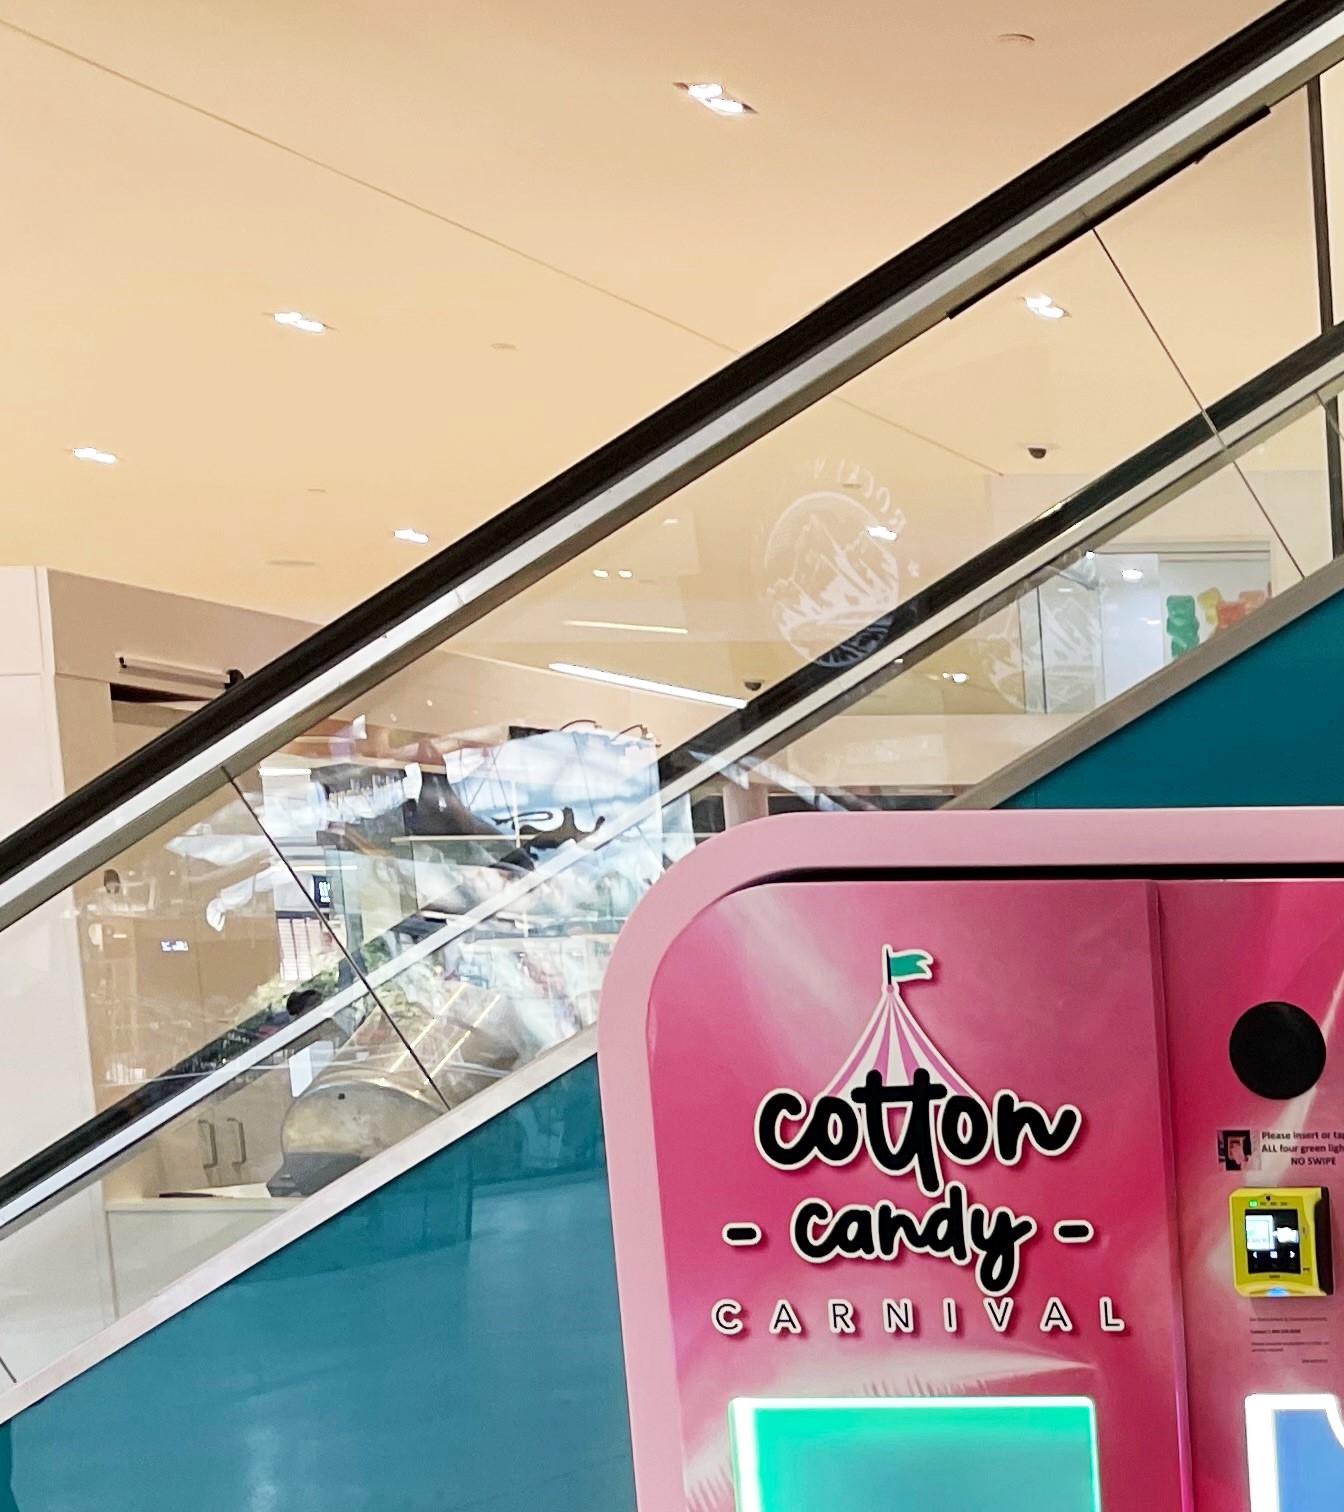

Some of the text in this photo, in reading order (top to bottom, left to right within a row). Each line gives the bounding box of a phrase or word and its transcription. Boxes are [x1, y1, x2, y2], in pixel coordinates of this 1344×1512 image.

[756, 1067, 1081, 1196] cotton
[1261, 1131, 1291, 1139] Please
[1293, 1131, 1319, 1139] insert
[1261, 1144, 1278, 1153] ALL
[1280, 1144, 1298, 1153] four
[1300, 1145, 1326, 1154] green
[1291, 1156, 1336, 1166] NO SWIPE
[790, 1183, 1037, 1295] candy
[712, 1297, 1124, 1336] CARNIVAL
